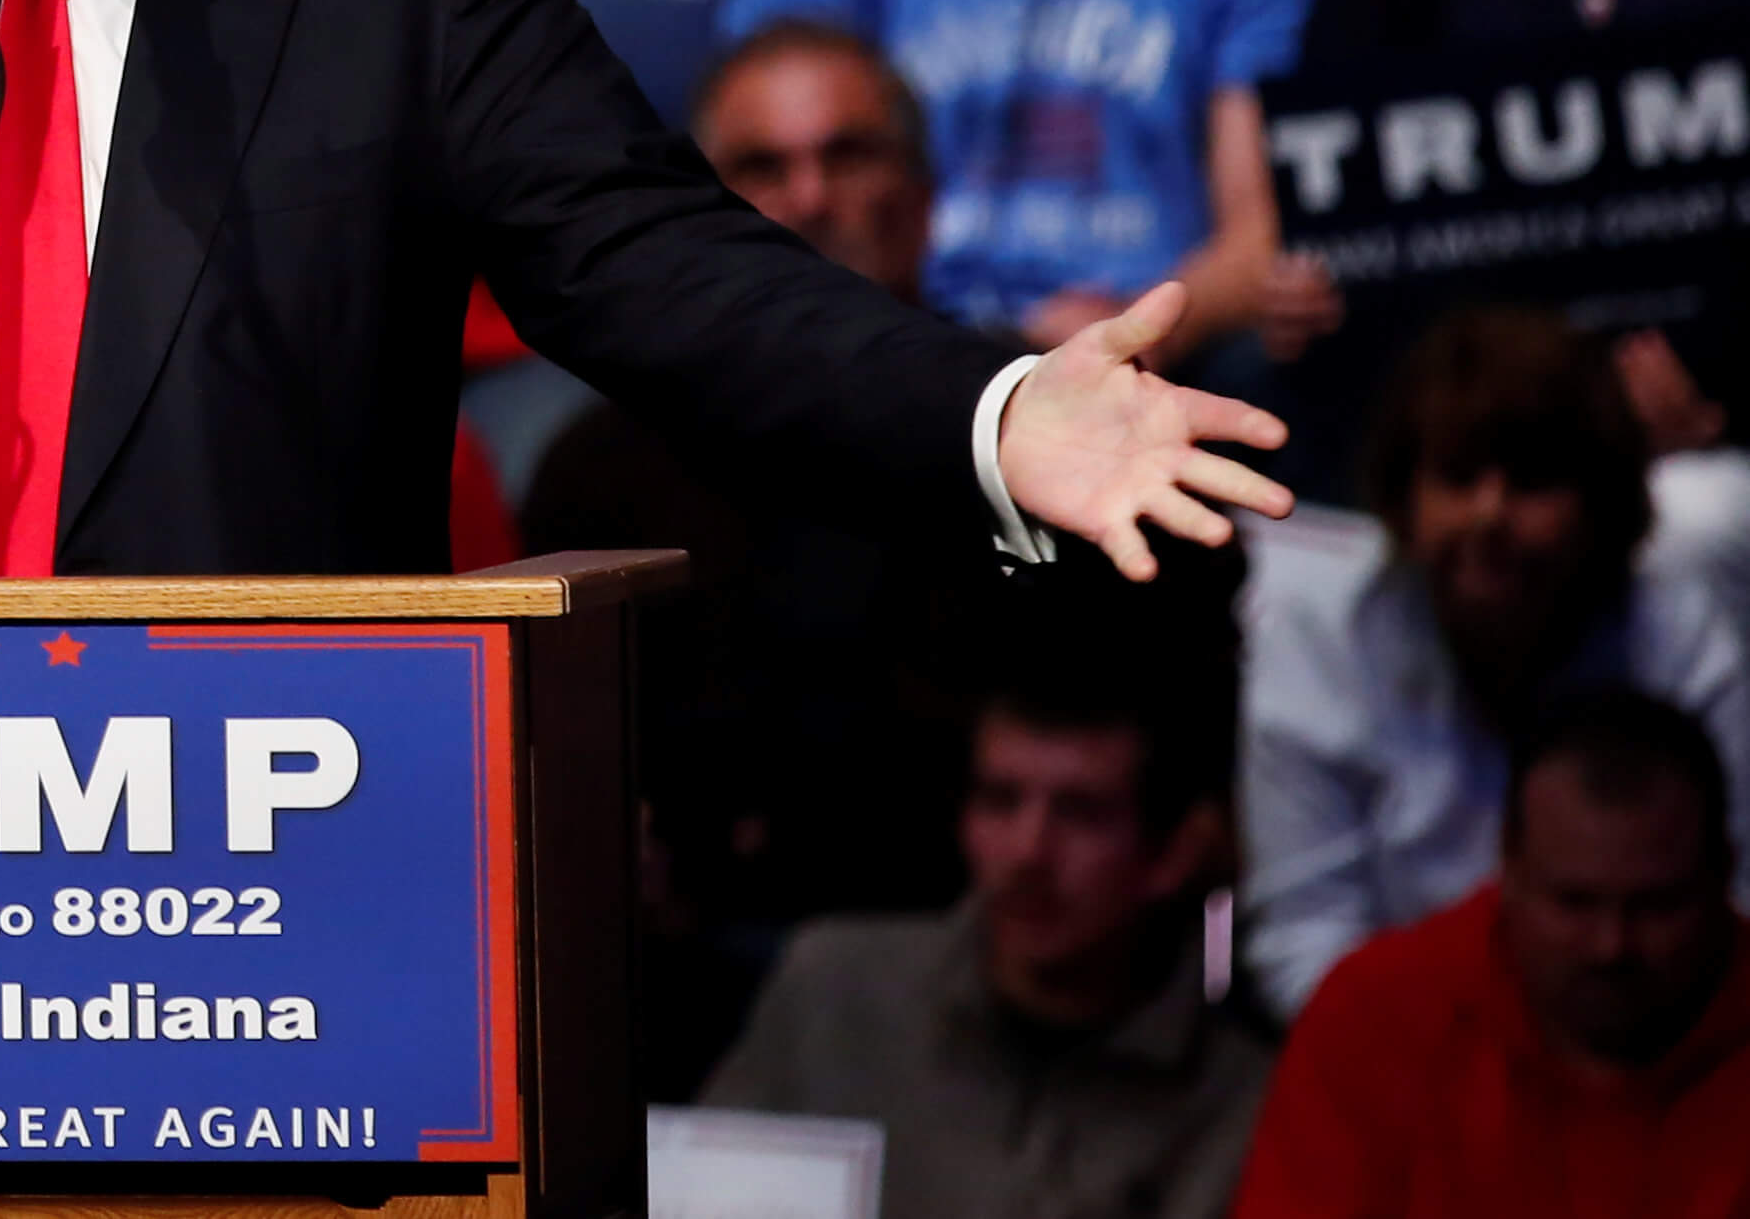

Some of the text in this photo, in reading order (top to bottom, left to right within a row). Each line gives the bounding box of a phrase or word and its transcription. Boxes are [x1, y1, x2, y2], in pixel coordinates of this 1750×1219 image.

[52, 887, 283, 937] 88022
[1, 983, 318, 1041] Indiana
[154, 1107, 376, 1149] AGAIN!
